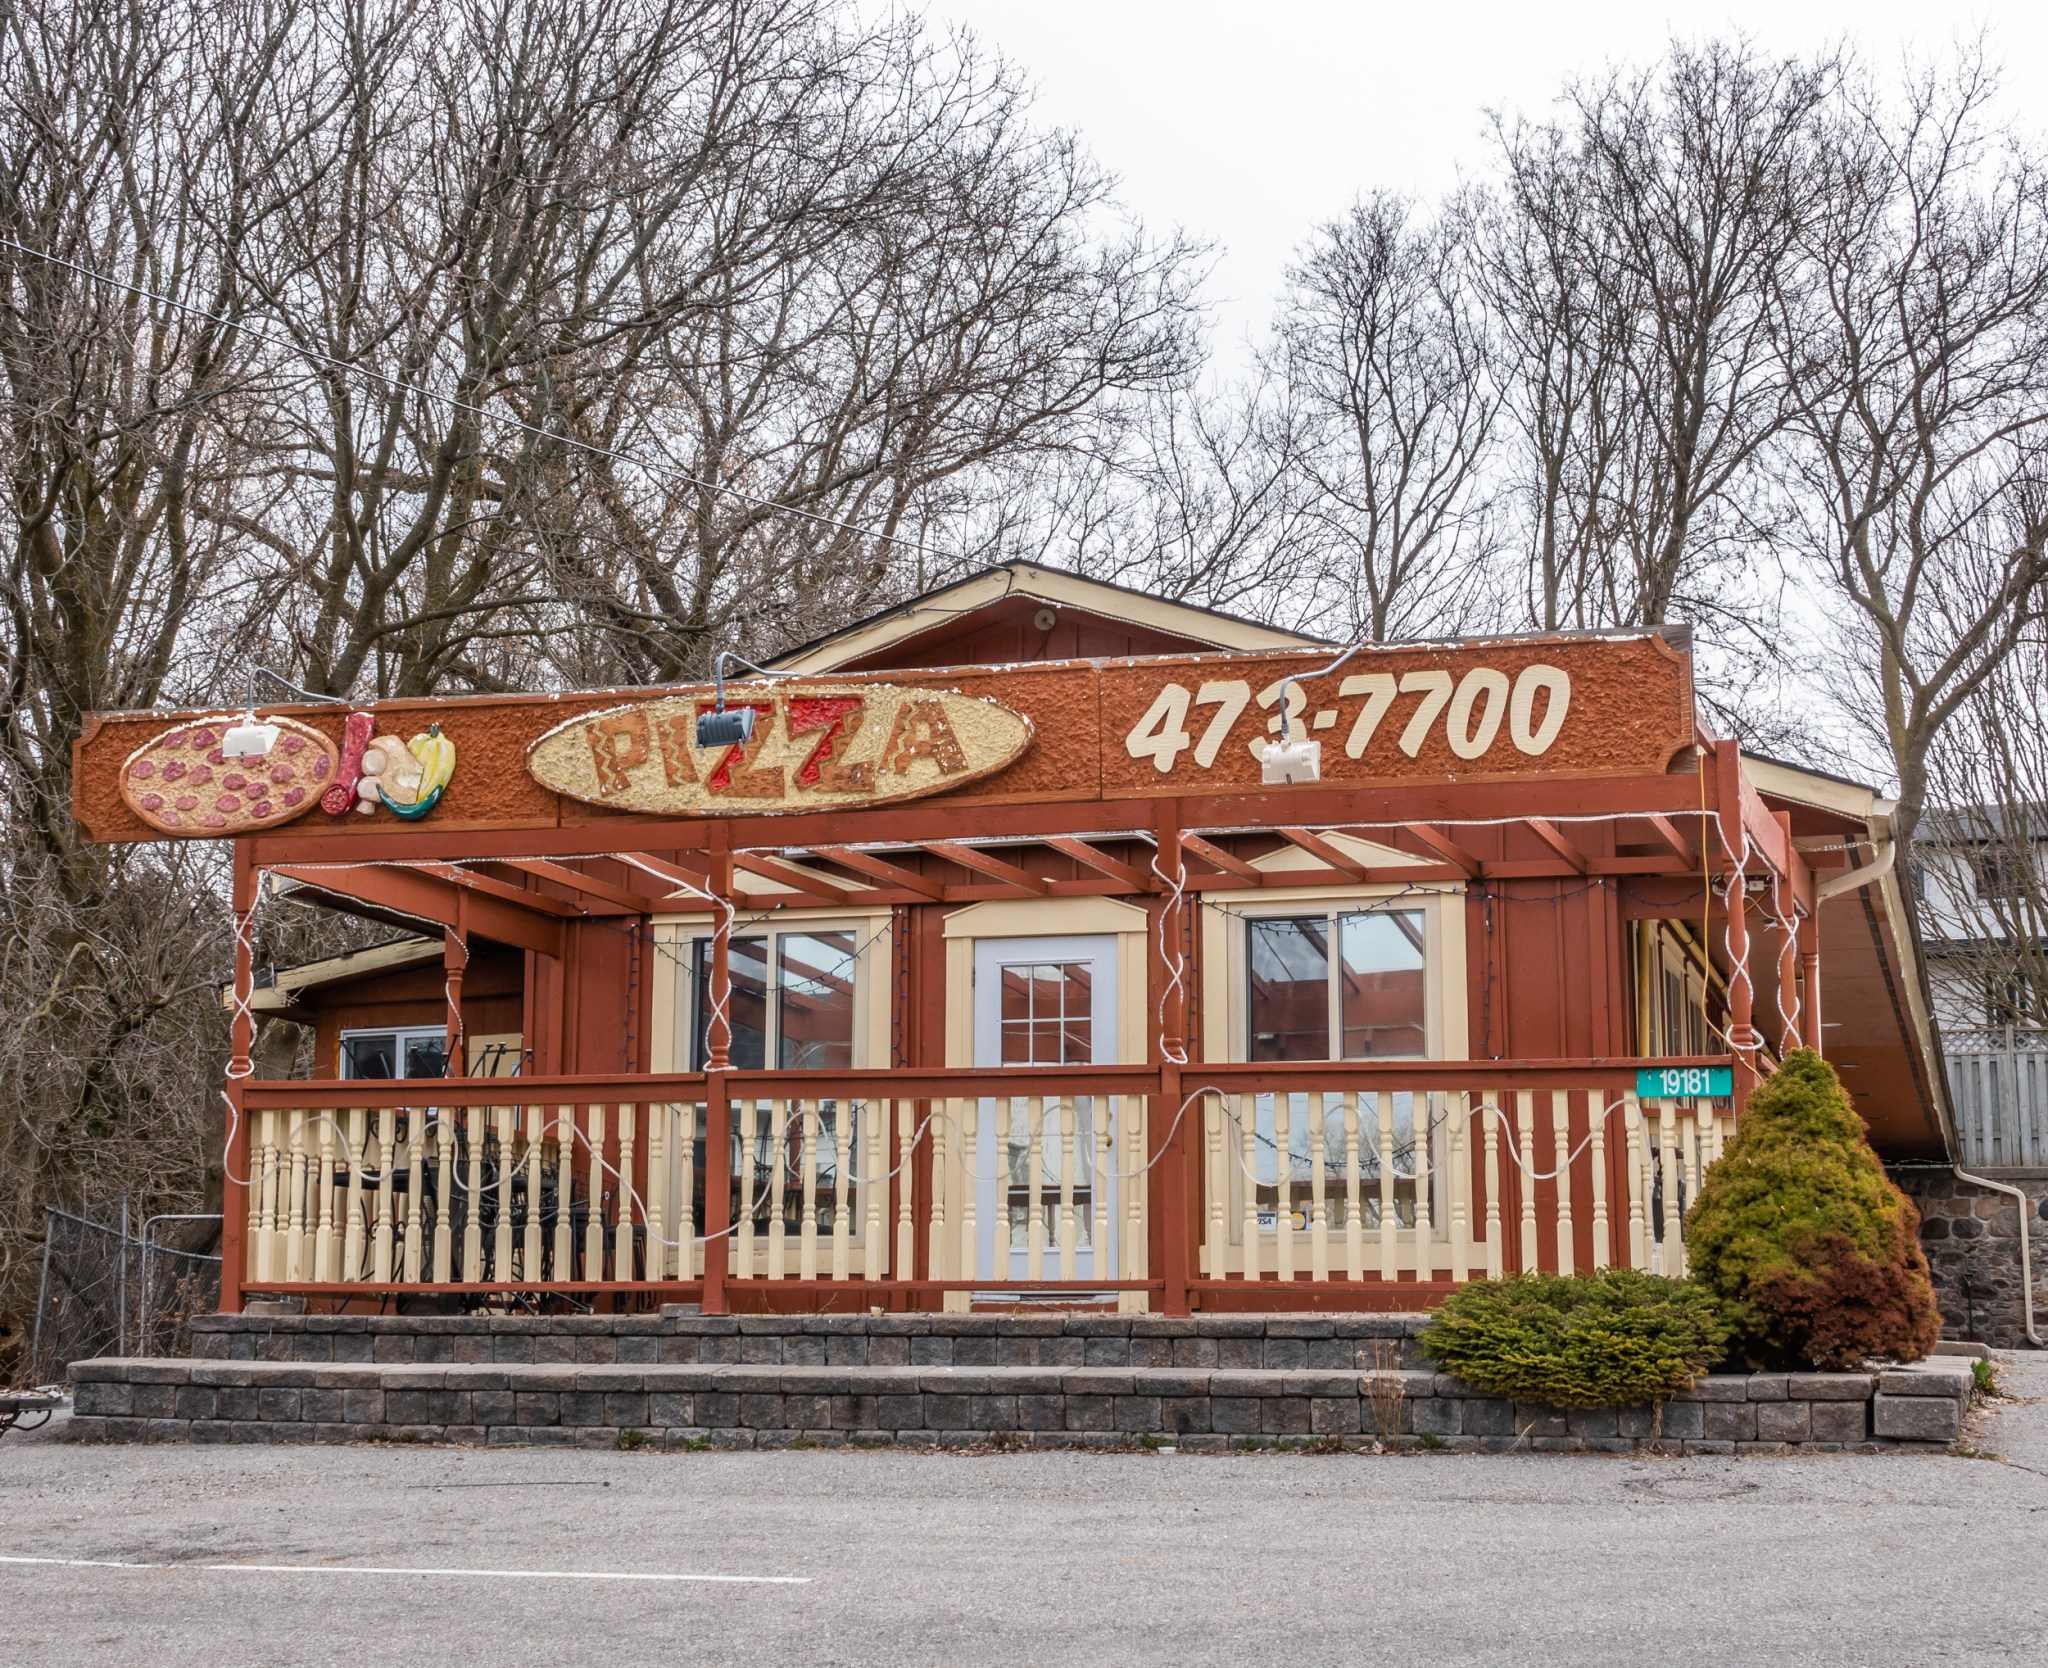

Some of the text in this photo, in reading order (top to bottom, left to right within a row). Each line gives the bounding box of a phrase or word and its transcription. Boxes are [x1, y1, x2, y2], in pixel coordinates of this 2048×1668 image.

[586, 693, 969, 798] PIZZA
[1125, 664, 1571, 773] 473-7700
[1659, 1068, 1710, 1095] 19181
